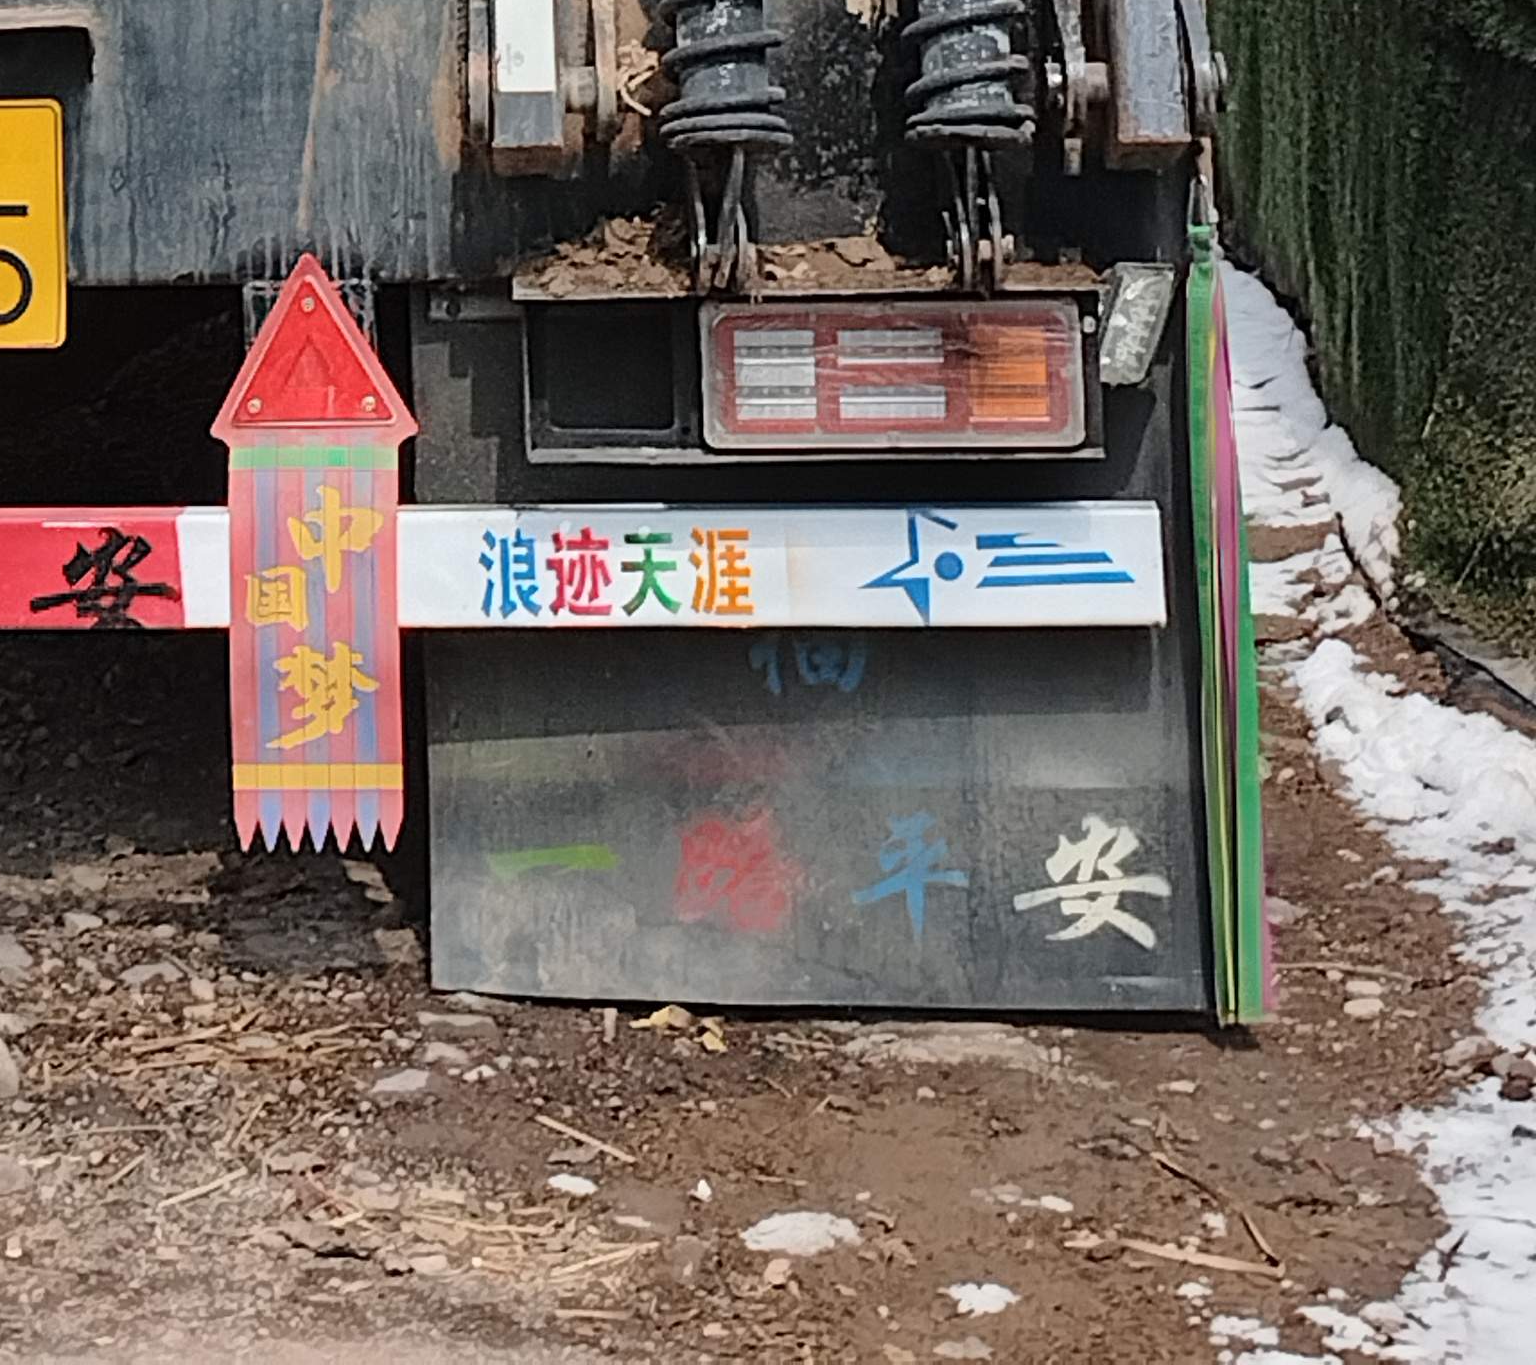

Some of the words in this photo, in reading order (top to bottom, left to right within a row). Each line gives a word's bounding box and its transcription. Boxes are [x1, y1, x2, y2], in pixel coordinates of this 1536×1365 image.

[244, 484, 384, 750] 中国梦
[477, 526, 756, 619] 浪迹天涯
